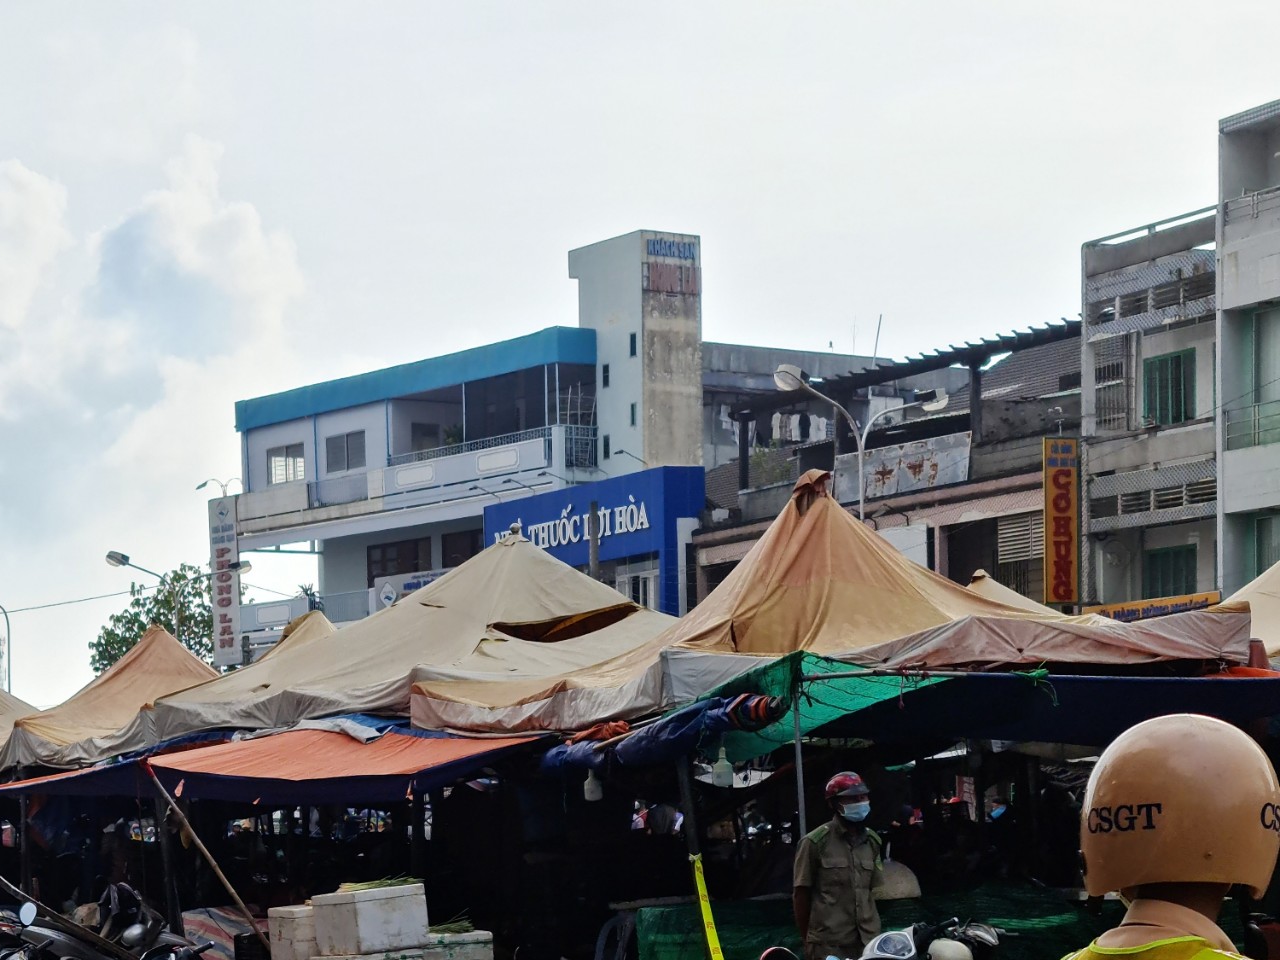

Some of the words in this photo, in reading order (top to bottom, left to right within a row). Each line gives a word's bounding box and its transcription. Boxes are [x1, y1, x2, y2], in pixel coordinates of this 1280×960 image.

[528, 504, 580, 550] THUỐC
[614, 494, 650, 534] HÒA
[1087, 802, 1162, 834] CSGT
